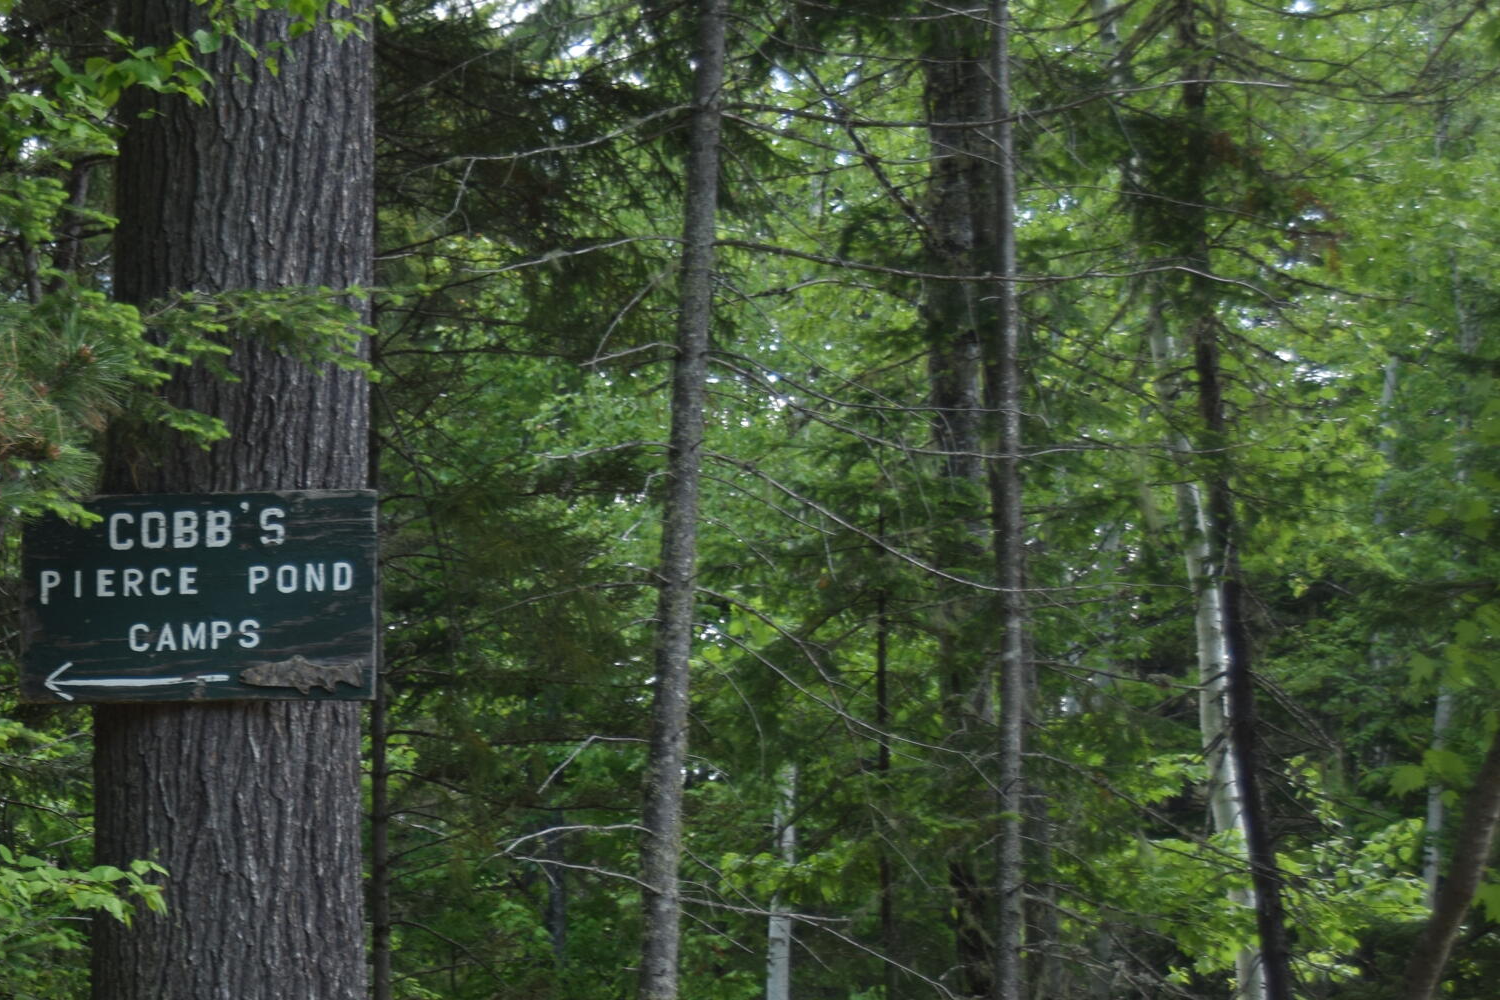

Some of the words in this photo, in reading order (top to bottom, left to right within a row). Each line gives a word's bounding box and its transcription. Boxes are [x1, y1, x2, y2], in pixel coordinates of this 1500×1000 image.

[108, 501, 286, 551] COBB'S
[39, 566, 199, 605] PIERCE
[248, 561, 353, 595] POND
[128, 619, 261, 652] CAMPS
